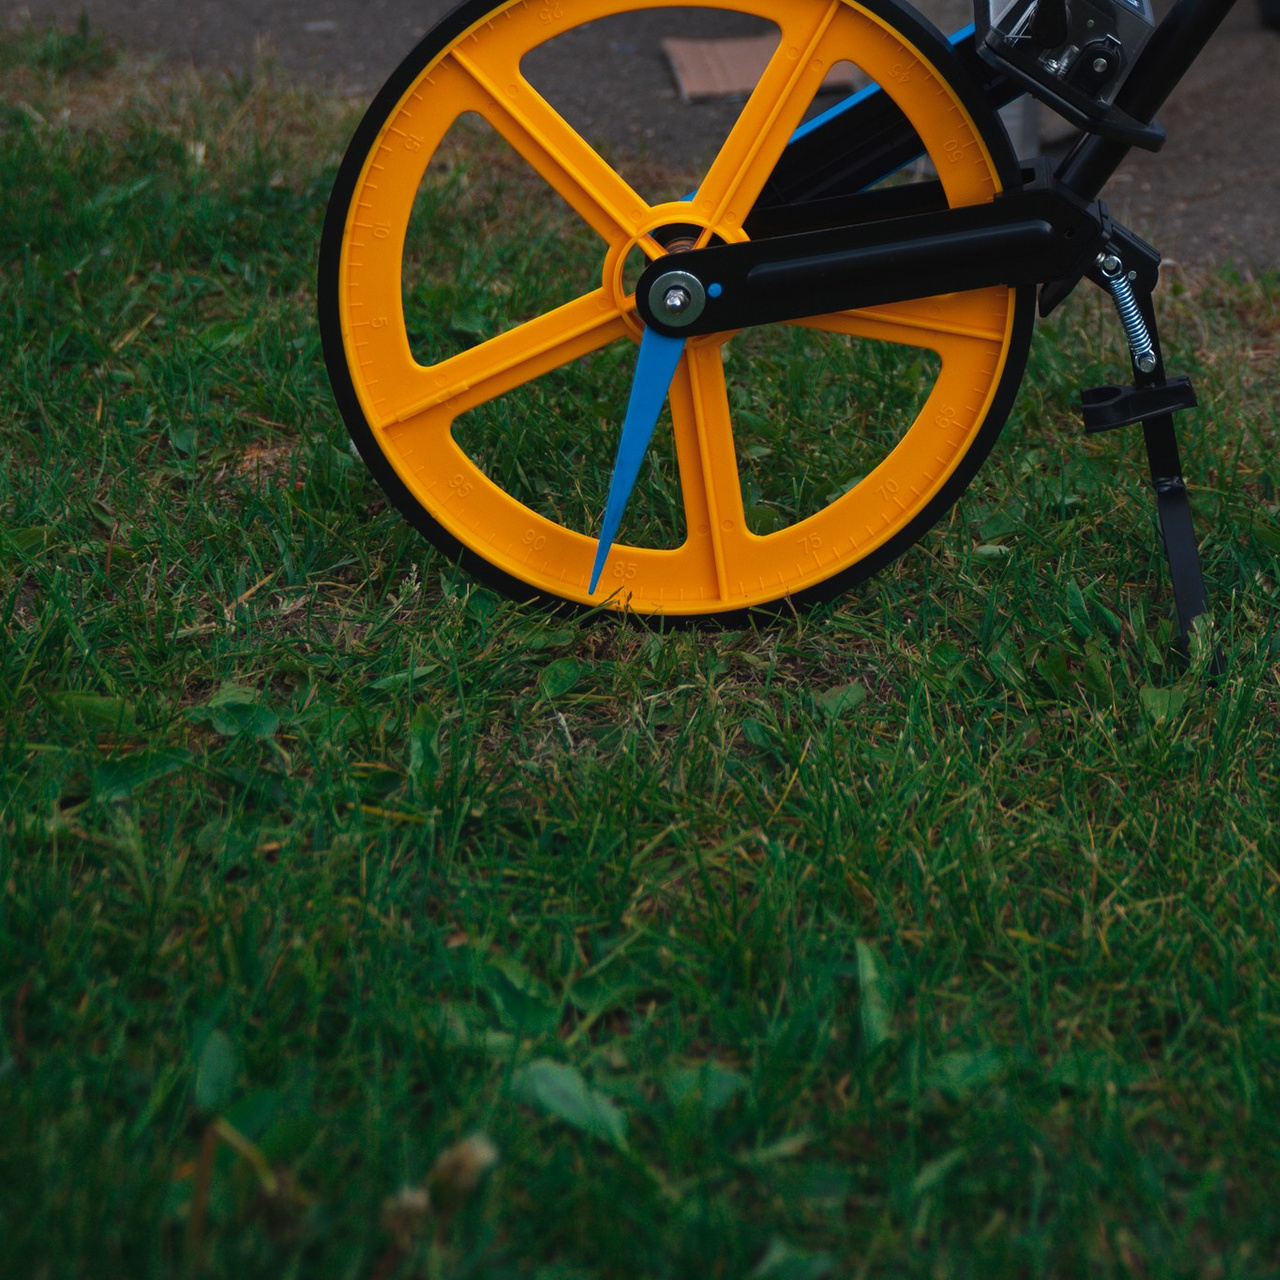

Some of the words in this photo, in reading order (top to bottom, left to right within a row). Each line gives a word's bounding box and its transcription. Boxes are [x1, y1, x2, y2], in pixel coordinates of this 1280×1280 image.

[538, 4, 565, 25] 25
[887, 61, 913, 86] 45
[404, 132, 425, 154] 15
[941, 137, 964, 165] 50
[371, 219, 392, 240] 10
[370, 316, 389, 329] 5
[934, 403, 958, 430] 65
[447, 472, 473, 499] 95
[873, 477, 901, 503] 70
[521, 527, 548, 552] 90
[796, 531, 824, 556] 75
[612, 559, 639, 579] 85
